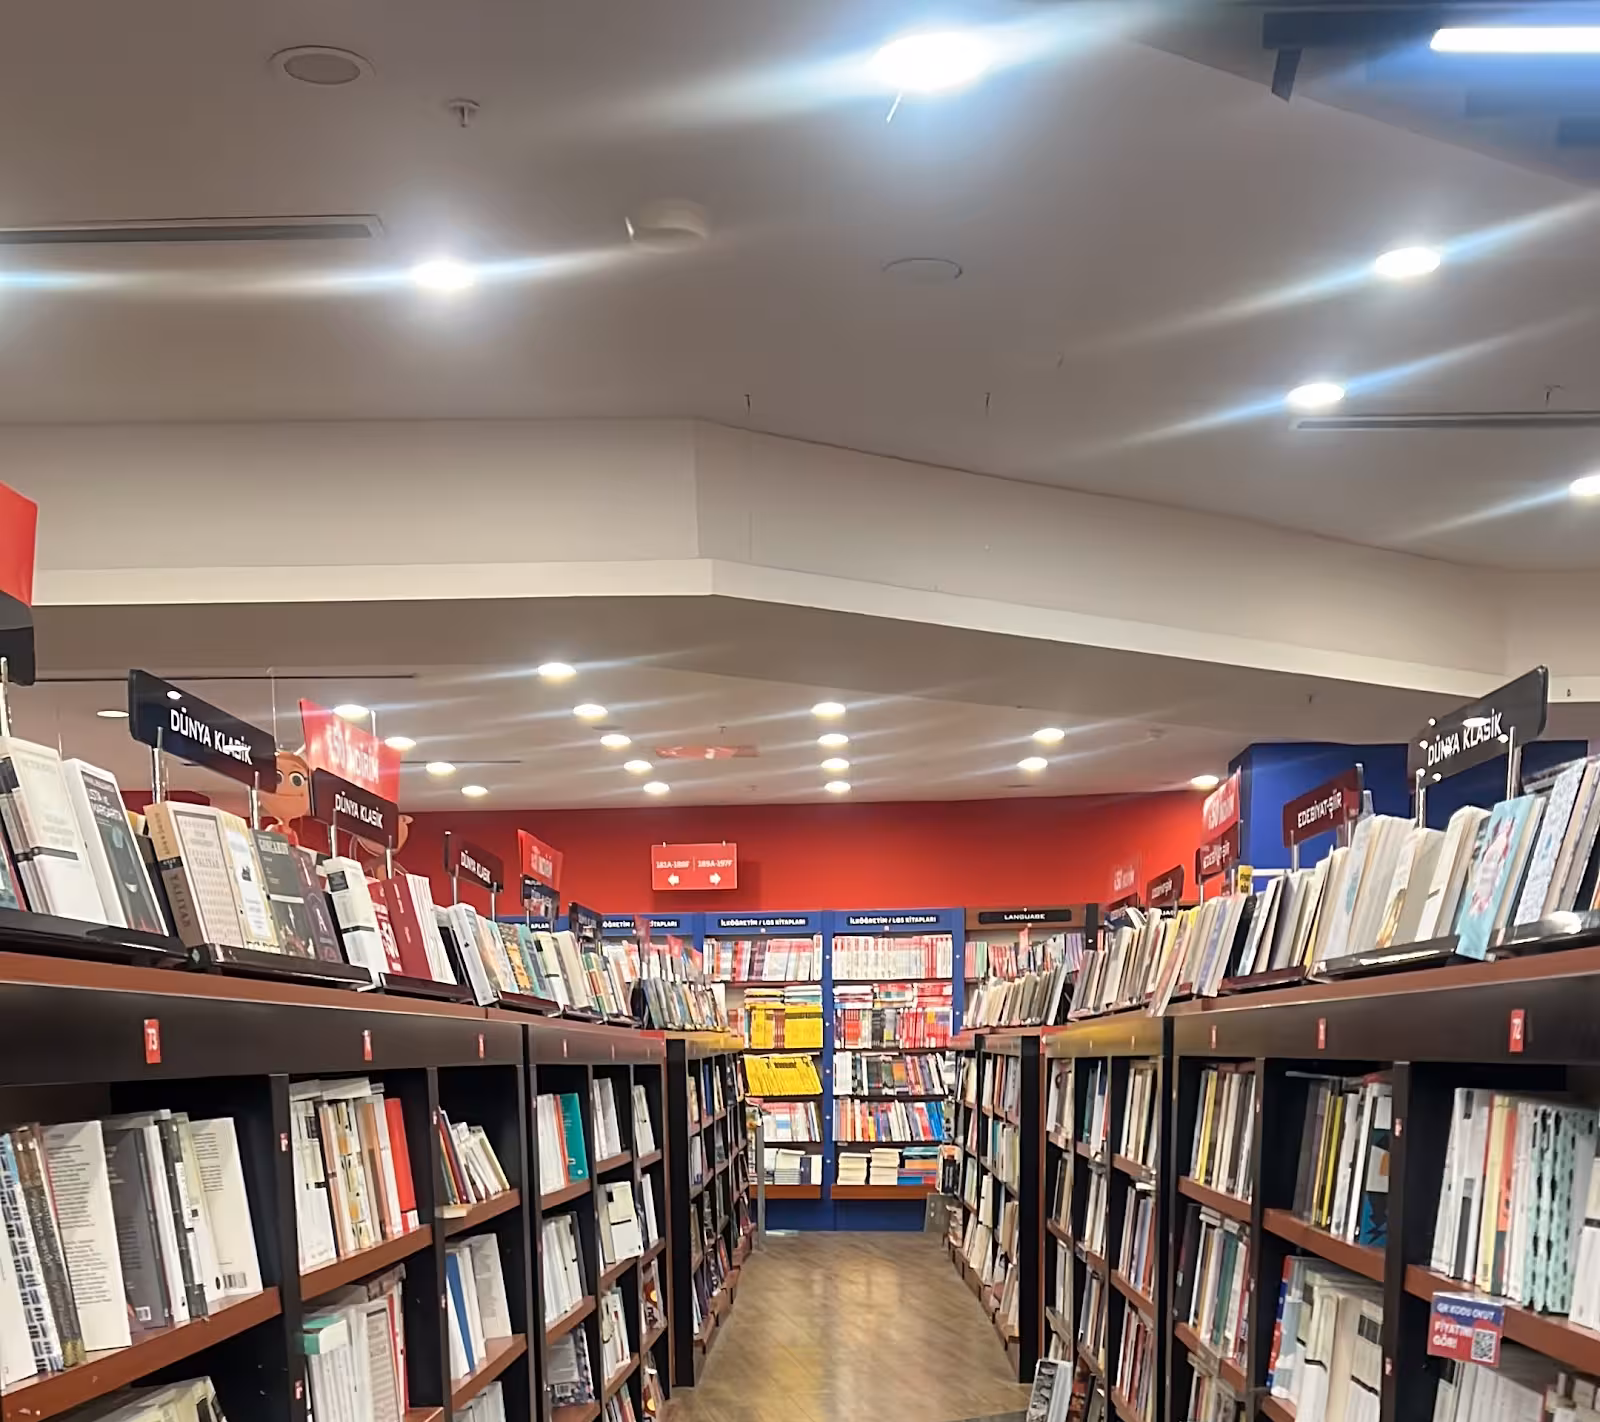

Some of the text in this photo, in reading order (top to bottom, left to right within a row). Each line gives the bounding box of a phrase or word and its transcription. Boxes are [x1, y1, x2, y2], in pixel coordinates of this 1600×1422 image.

[171, 706, 253, 765] DÜNYA KLASİK
[1427, 708, 1503, 767] DÜNYA KLASİK
[334, 791, 384, 829] DÜNYA KLASİK
[1297, 788, 1343, 829] EDEBİYAT-ŞİİR
[602, 920, 631, 928] ÖĞRETİM
